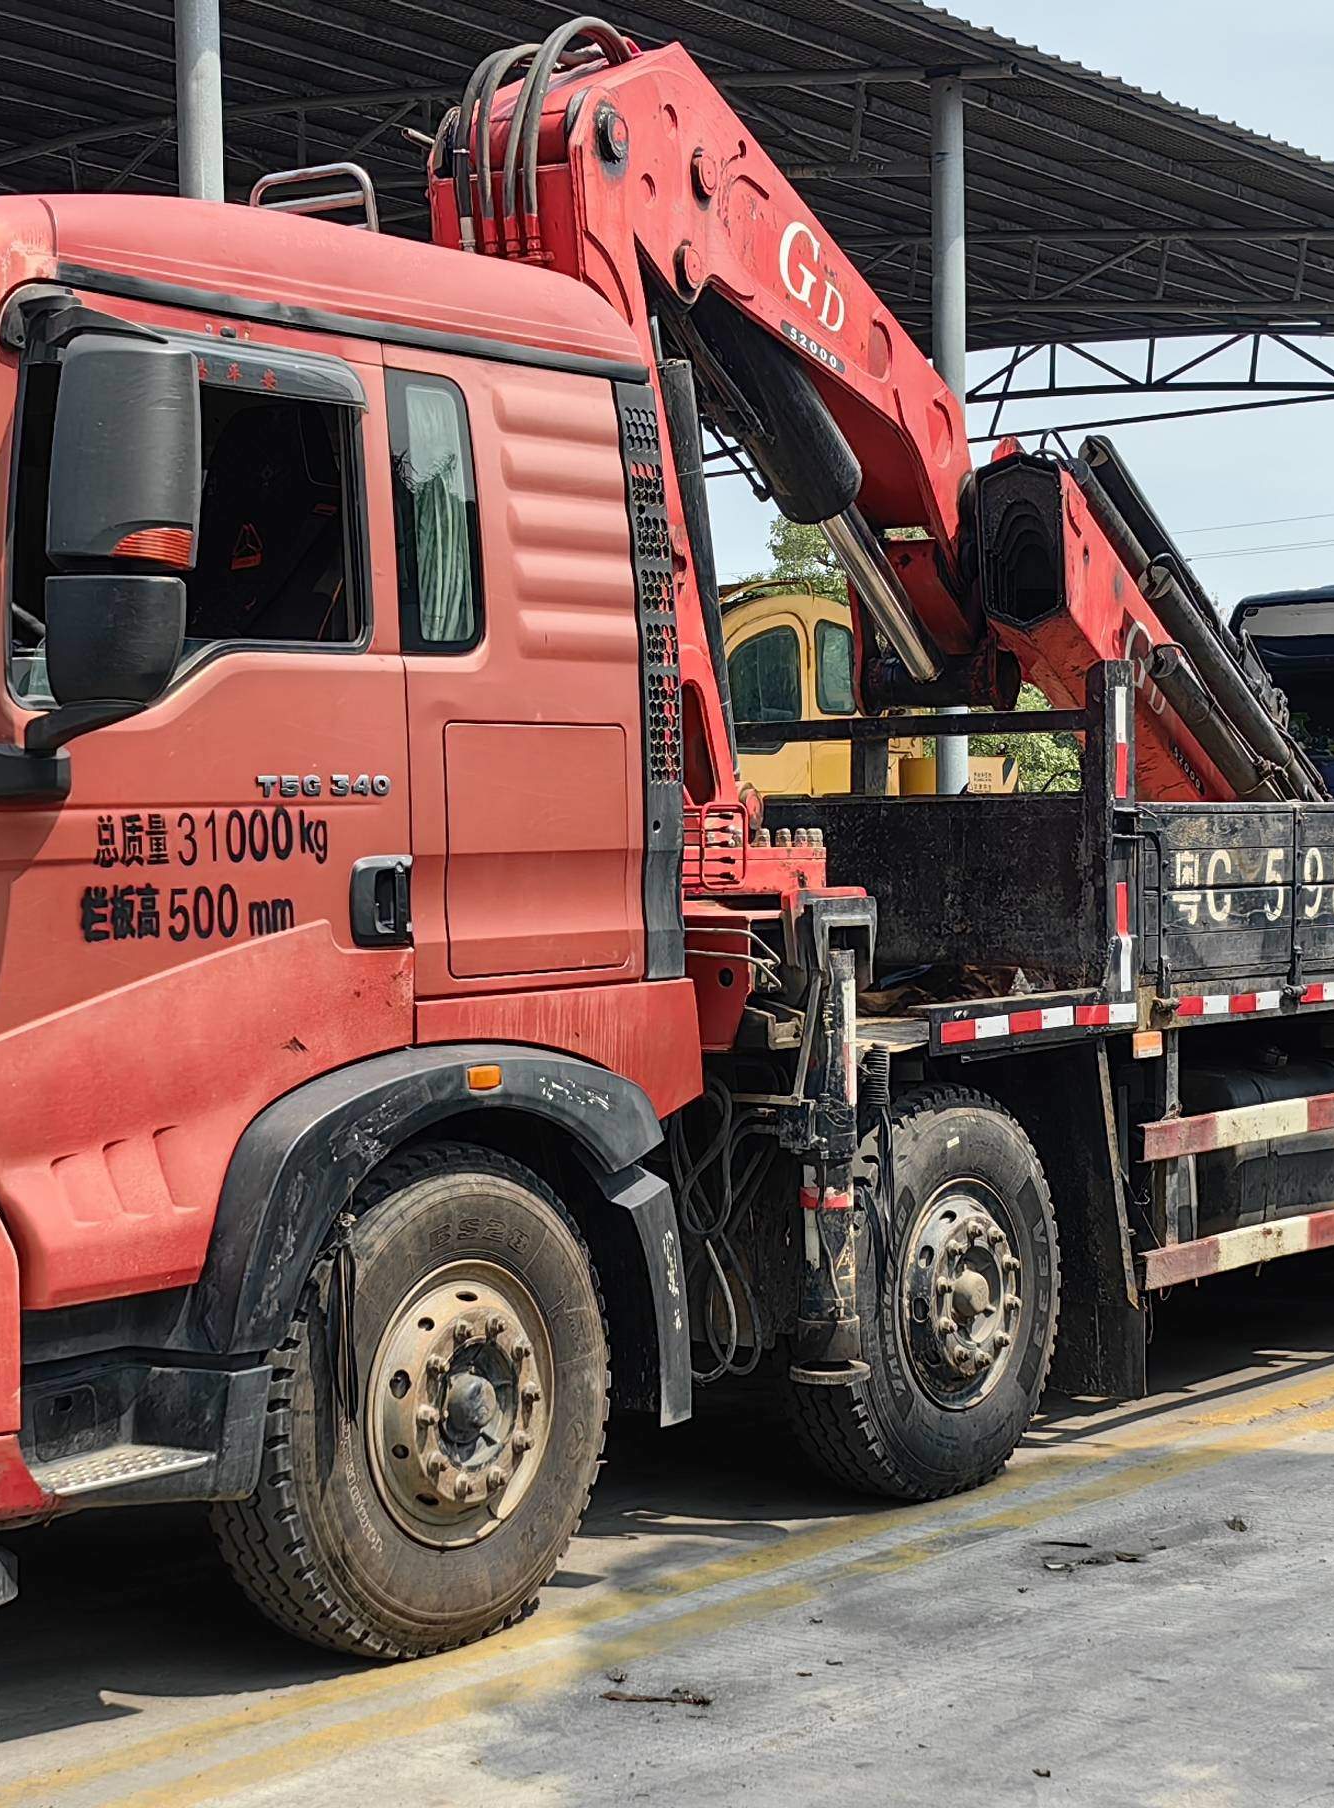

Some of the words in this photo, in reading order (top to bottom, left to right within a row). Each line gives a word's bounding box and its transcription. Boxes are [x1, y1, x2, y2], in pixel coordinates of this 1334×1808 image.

[789, 327, 838, 369] 52000
[256, 774, 322, 797] T5G
[330, 774, 391, 797] 340
